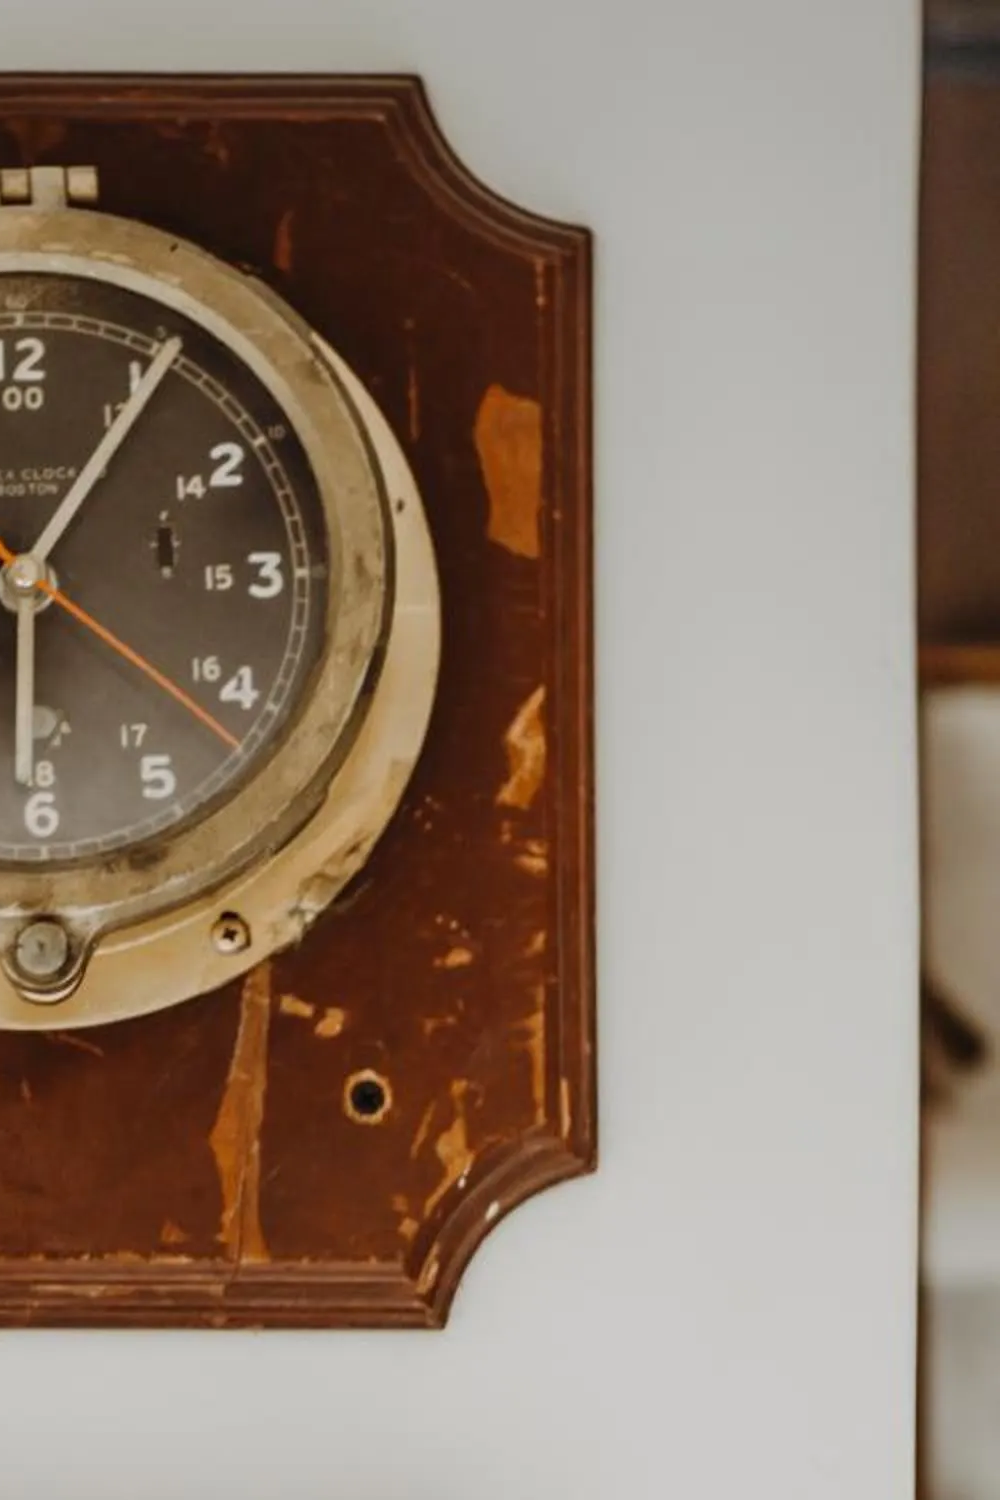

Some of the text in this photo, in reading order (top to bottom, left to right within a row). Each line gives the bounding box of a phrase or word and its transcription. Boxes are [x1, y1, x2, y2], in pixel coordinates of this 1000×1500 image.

[3, 386, 43, 410] 00
[210, 443, 243, 486] 2
[177, 475, 206, 499] 14
[205, 565, 233, 590] 15
[248, 553, 283, 598] 3
[193, 656, 221, 681] 16
[219, 664, 259, 709] 4
[121, 724, 147, 747] 17
[141, 755, 175, 799] 5
[24, 792, 59, 837] 6
